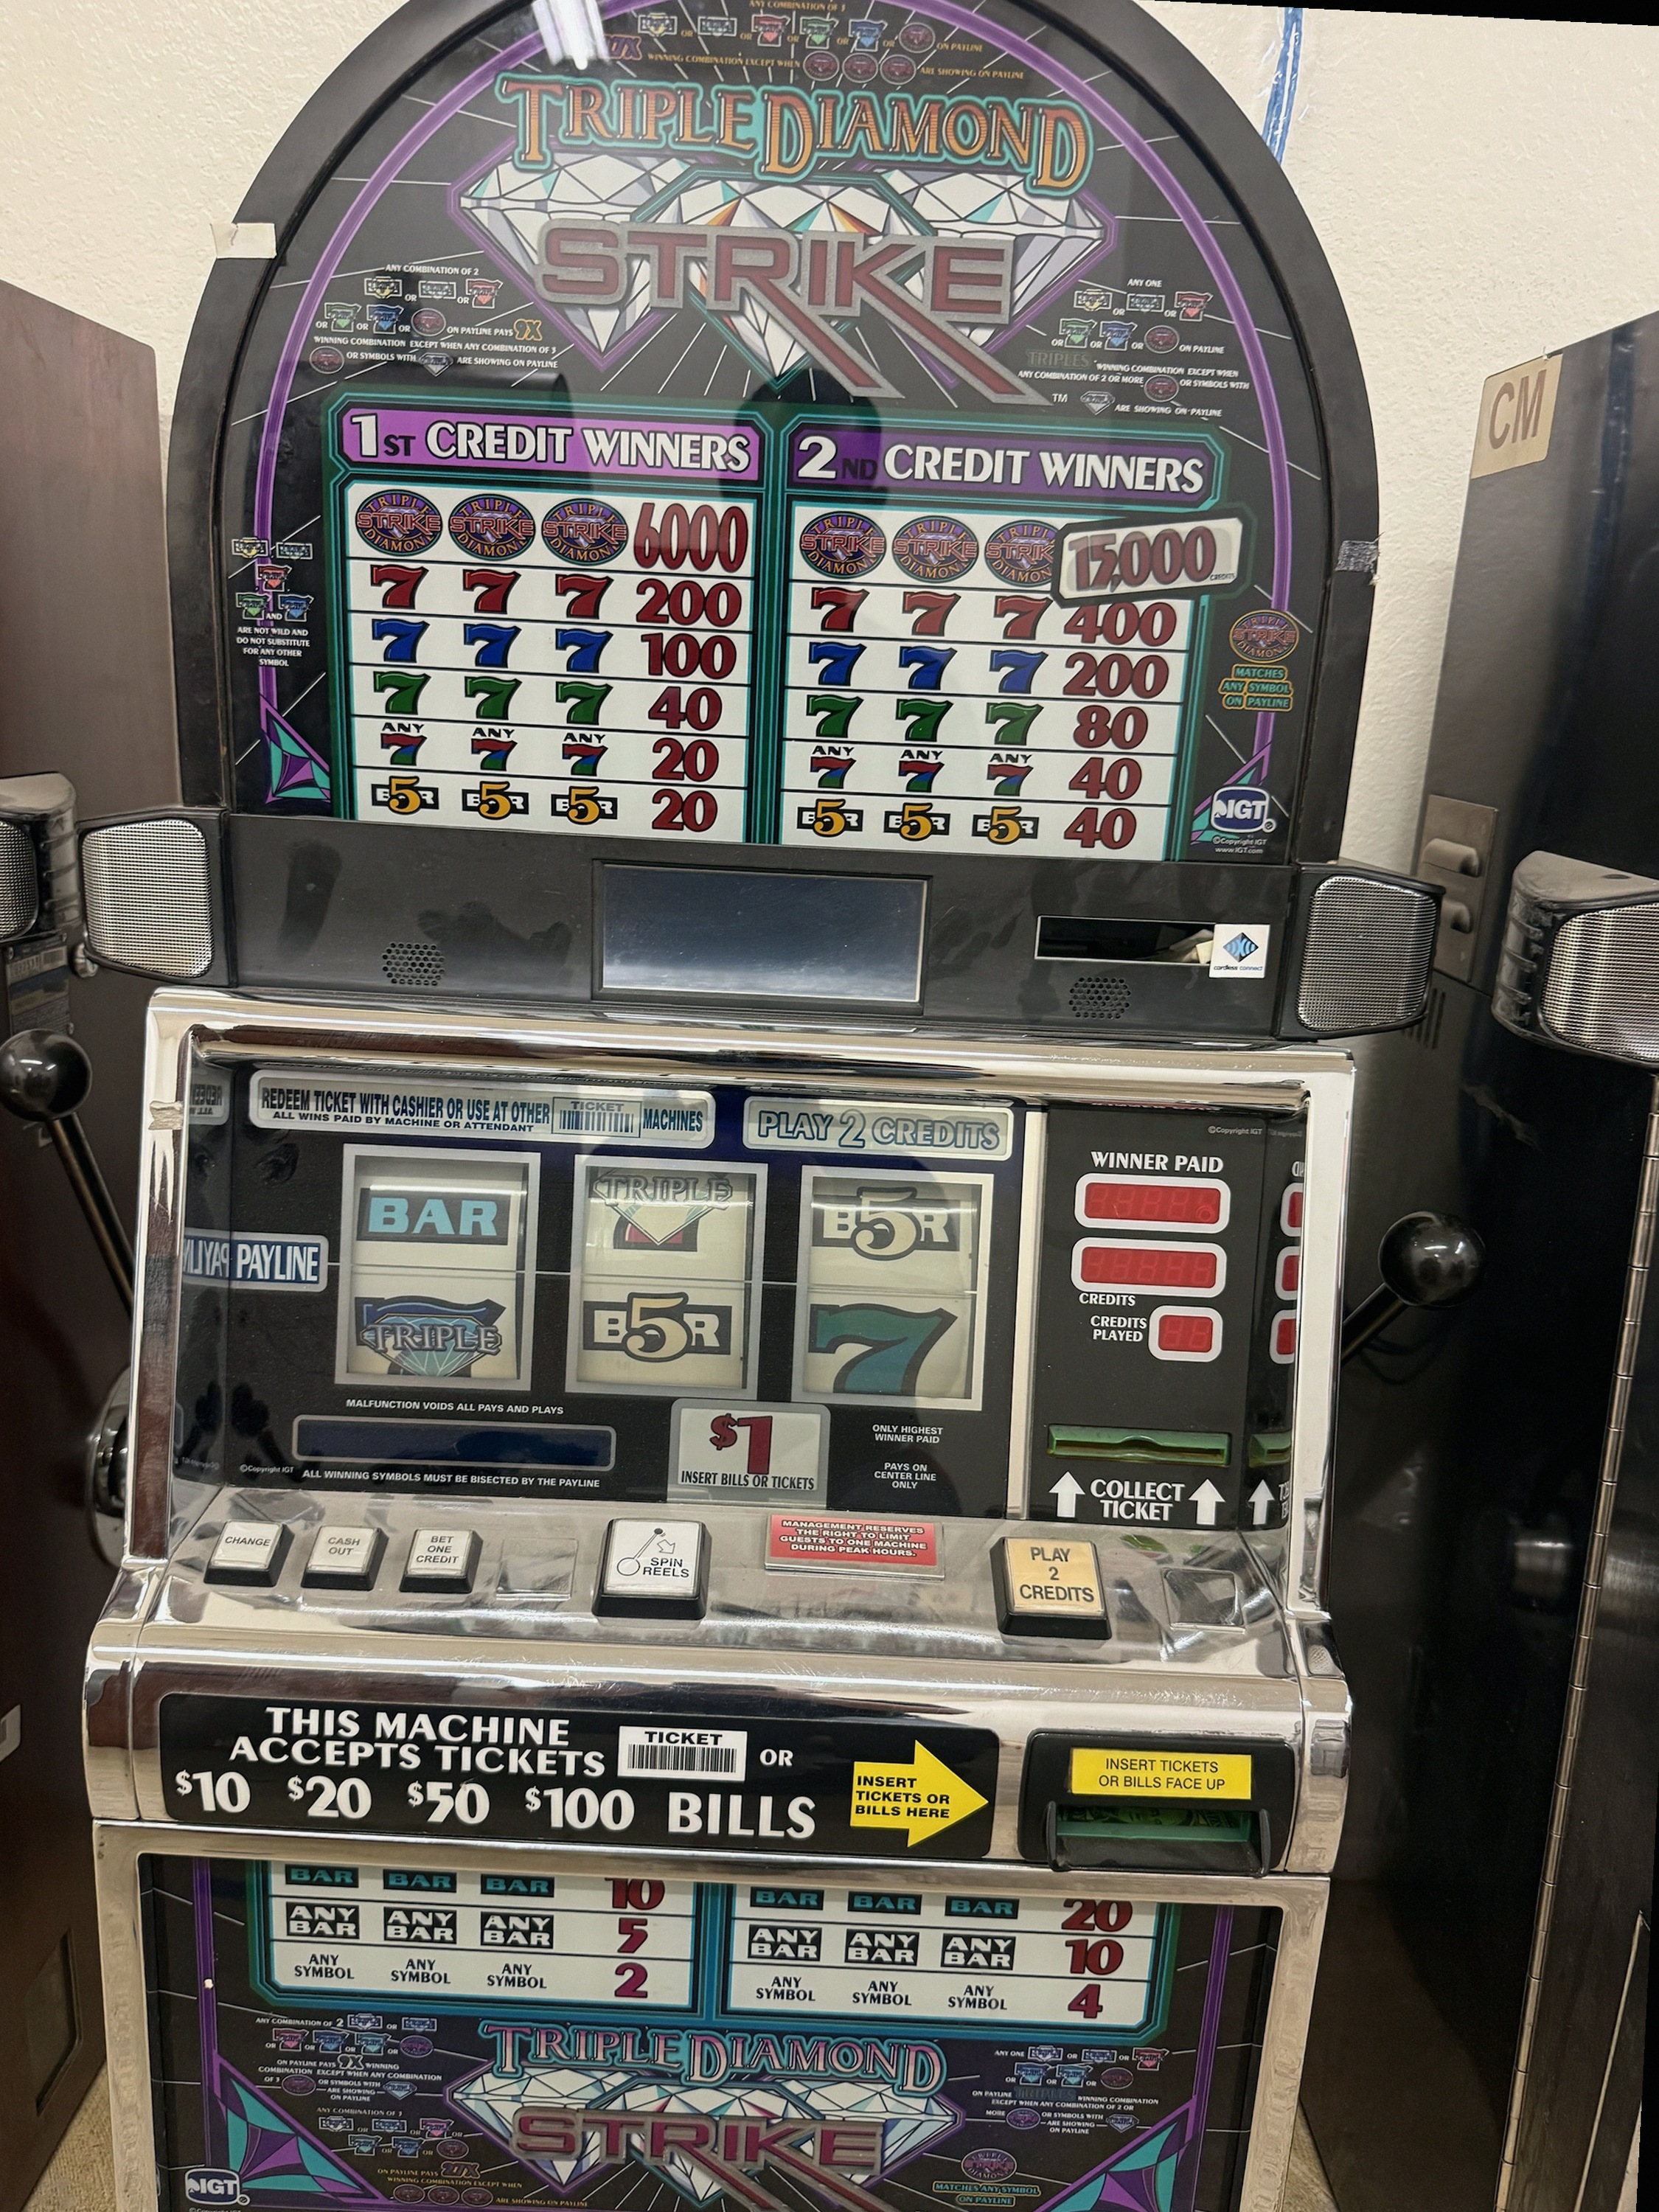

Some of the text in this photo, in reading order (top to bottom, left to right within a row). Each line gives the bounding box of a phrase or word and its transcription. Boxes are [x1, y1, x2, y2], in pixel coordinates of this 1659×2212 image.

[497, 74, 1092, 195] TRIPLE DIAMOND
[403, 265, 459, 274] COMBINATION
[1127, 279, 1162, 288] ANY ONE
[536, 219, 1053, 406] STRIKE
[1018, 370, 1032, 378] ANY
[1034, 372, 1087, 381] COMBINATION
[1121, 376, 1144, 384] MORE
[1489, 369, 1547, 449] CM
[426, 421, 572, 462] CREDIT
[584, 428, 751, 471] WINNERS
[886, 445, 1031, 484] CREDIT
[1040, 451, 1203, 493] WINNERS
[633, 503, 748, 573] 6000
[1068, 526, 1217, 593] 15,000
[636, 578, 742, 627] 200
[1064, 602, 1177, 647] 400
[641, 633, 737, 679] 100
[1062, 652, 1169, 699] 200
[1235, 668, 1284, 678] MATCHES
[1222, 681, 1290, 694] ANY SYMBOL
[648, 686, 722, 731] 40
[1225, 697, 1289, 709] ON PAYLINE
[1073, 706, 1148, 750] 80
[652, 738, 719, 782] 20
[1069, 757, 1142, 800] 40
[1226, 799, 1265, 820] IGT
[262, 1087, 703, 1133] REDEEM TICKET WITH CASHIER OR USE AT OTHER TICKET MACHINES
[274, 1111, 296, 1119] ALL
[299, 1113, 330, 1121] WINS
[334, 1115, 362, 1123] PAID
[384, 1118, 440, 1127] MACHINE
[444, 1120, 461, 1128] OR
[463, 1121, 534, 1132] ATTENDANT
[758, 1108, 999, 1150] PLAY 2 CREDITS
[1091, 1151, 1223, 1173] WINNER PAID
[367, 1197, 498, 1236] BAR
[236, 1242, 319, 1282] PAYLINE
[1079, 1293, 1135, 1307] CREDITS
[1091, 1315, 1147, 1329] CREDITS
[367, 1324, 500, 1355] TRIPLE
[1093, 1329, 1144, 1342] PLAYED
[346, 1399, 564, 1415] MALFUNCTION VOIDS ALL PAYS AND PLAYS
[873, 1425, 943, 1435] ONLY HIGHEST
[874, 1433, 940, 1444] WINNER PAID
[709, 1413, 773, 1475] $1
[884, 1462, 927, 1471] PAYS ON
[302, 1470, 599, 1487] ALL WINNING SYMBOLS MUST BE BISECTED BY THE PAYLINE
[681, 1470, 815, 1490] INSERT BILLS OR TICKETS
[874, 1470, 937, 1481] CENTER LINE
[892, 1481, 917, 1489] ONLY
[1090, 1479, 1185, 1502] COLLECT
[1100, 1500, 1173, 1521] TICKET
[782, 1520, 924, 1534] MANAGEMENT RESERVES
[796, 1528, 911, 1540] THE RIGHT TO LIMIT
[224, 1536, 271, 1547] CHANGE
[327, 1537, 361, 1545] CASH
[431, 1535, 453, 1544] BET
[779, 1535, 826, 1545] GUESTS
[874, 1540, 926, 1549] MACHINE
[328, 1547, 353, 1556] OUT
[427, 1545, 451, 1554] ONE
[790, 1543, 916, 1557] DURING PEAK HOURS.
[1031, 1547, 1070, 1562] PLAY
[416, 1555, 459, 1564] CREDIT
[650, 1557, 684, 1568] SPIN
[642, 1567, 689, 1578] REELS
[1049, 1567, 1060, 1580] 2
[1020, 1585, 1094, 1602] CREDITS
[265, 1707, 570, 1747] THIS MACHINE
[229, 1731, 793, 1778] ACCEPTS TICKETS TICKET OR
[1106, 1759, 1218, 1773] INSERT TICKETS
[1099, 1775, 1225, 1790] OR BILLS FACE UP
[175, 1770, 816, 1839] $10 $20 $50 $100 BILLS
[309, 1954, 339, 1966] ANY
[294, 1965, 354, 1980] SYMBOL
[614, 1962, 648, 1998] 2
[1068, 1983, 1102, 2019] 4
[481, 2021, 946, 2095] TRIPLE DIAMOND
